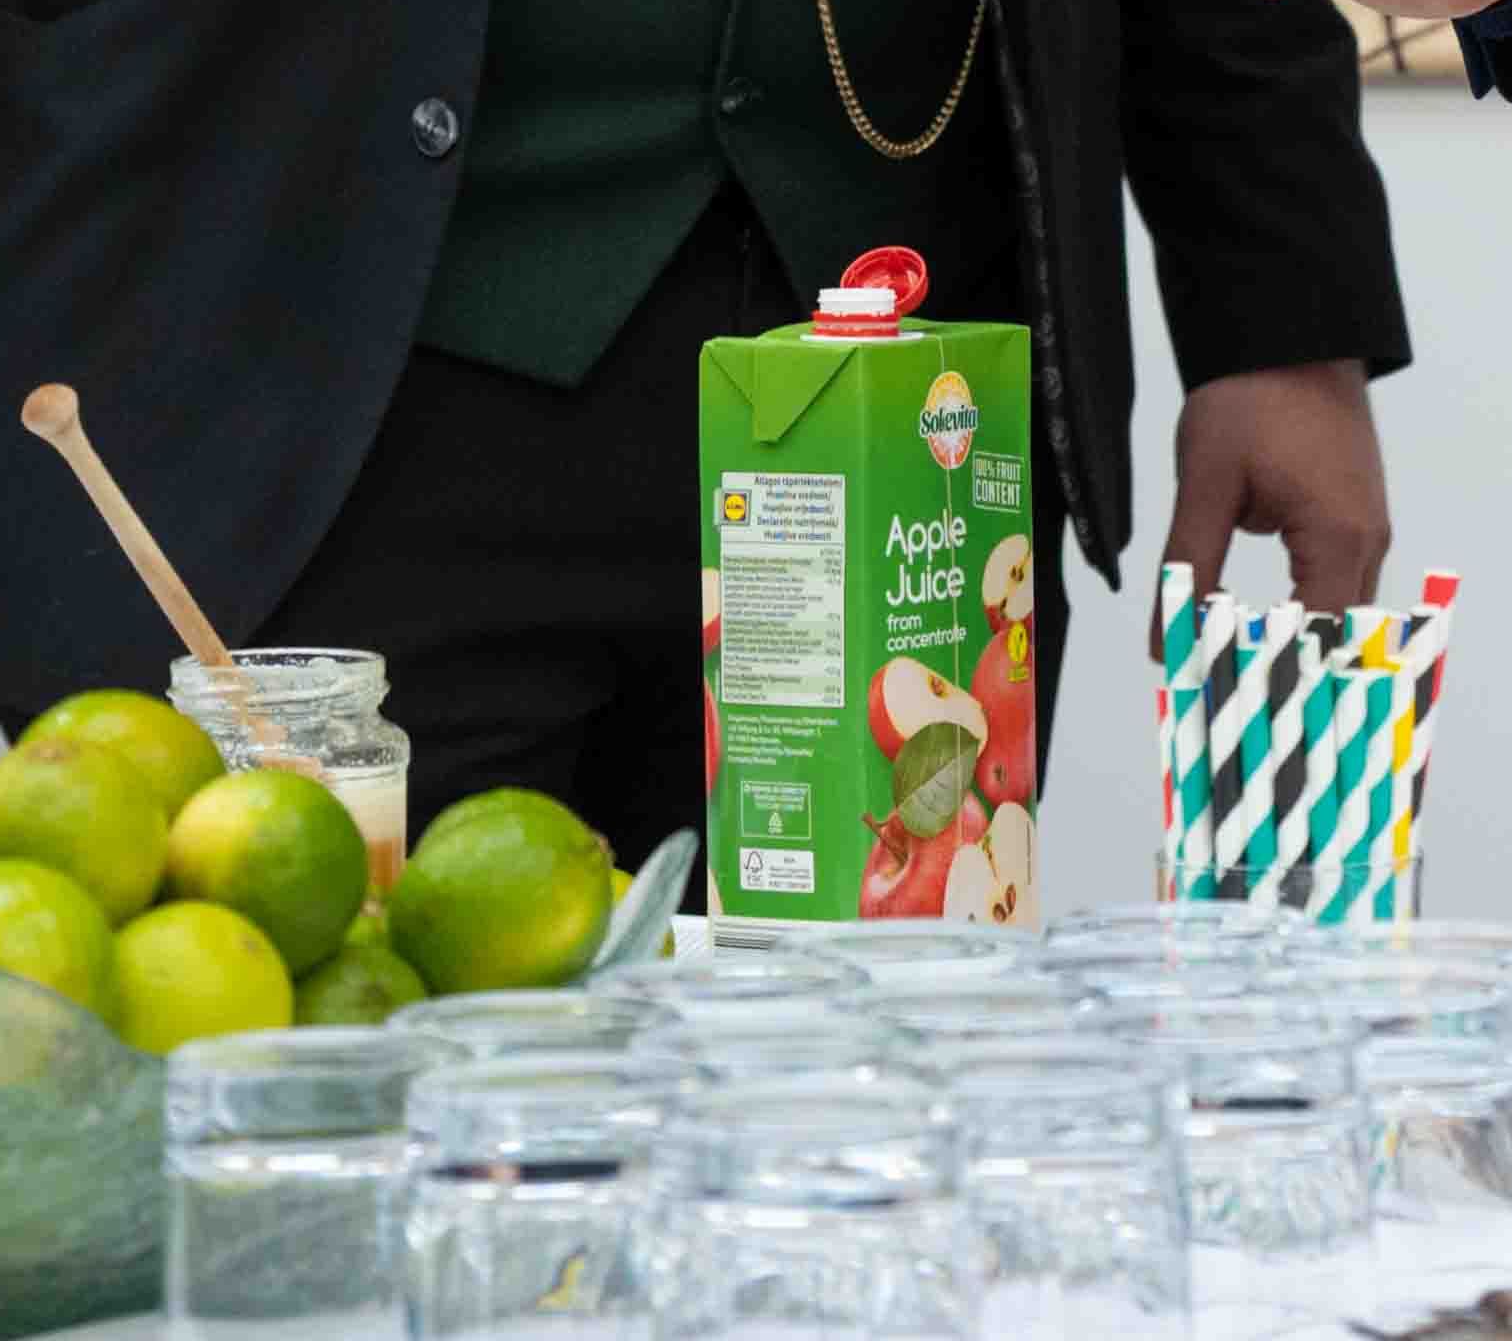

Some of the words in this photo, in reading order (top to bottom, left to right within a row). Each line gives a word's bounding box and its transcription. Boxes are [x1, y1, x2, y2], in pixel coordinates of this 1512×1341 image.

[920, 405, 978, 436] Solevita
[997, 460, 1021, 481] FRUIT
[975, 478, 1021, 507] CONTENT
[885, 509, 967, 565] Apple
[885, 564, 966, 606] Juice
[886, 613, 922, 633] from
[886, 622, 968, 652] concentrate
